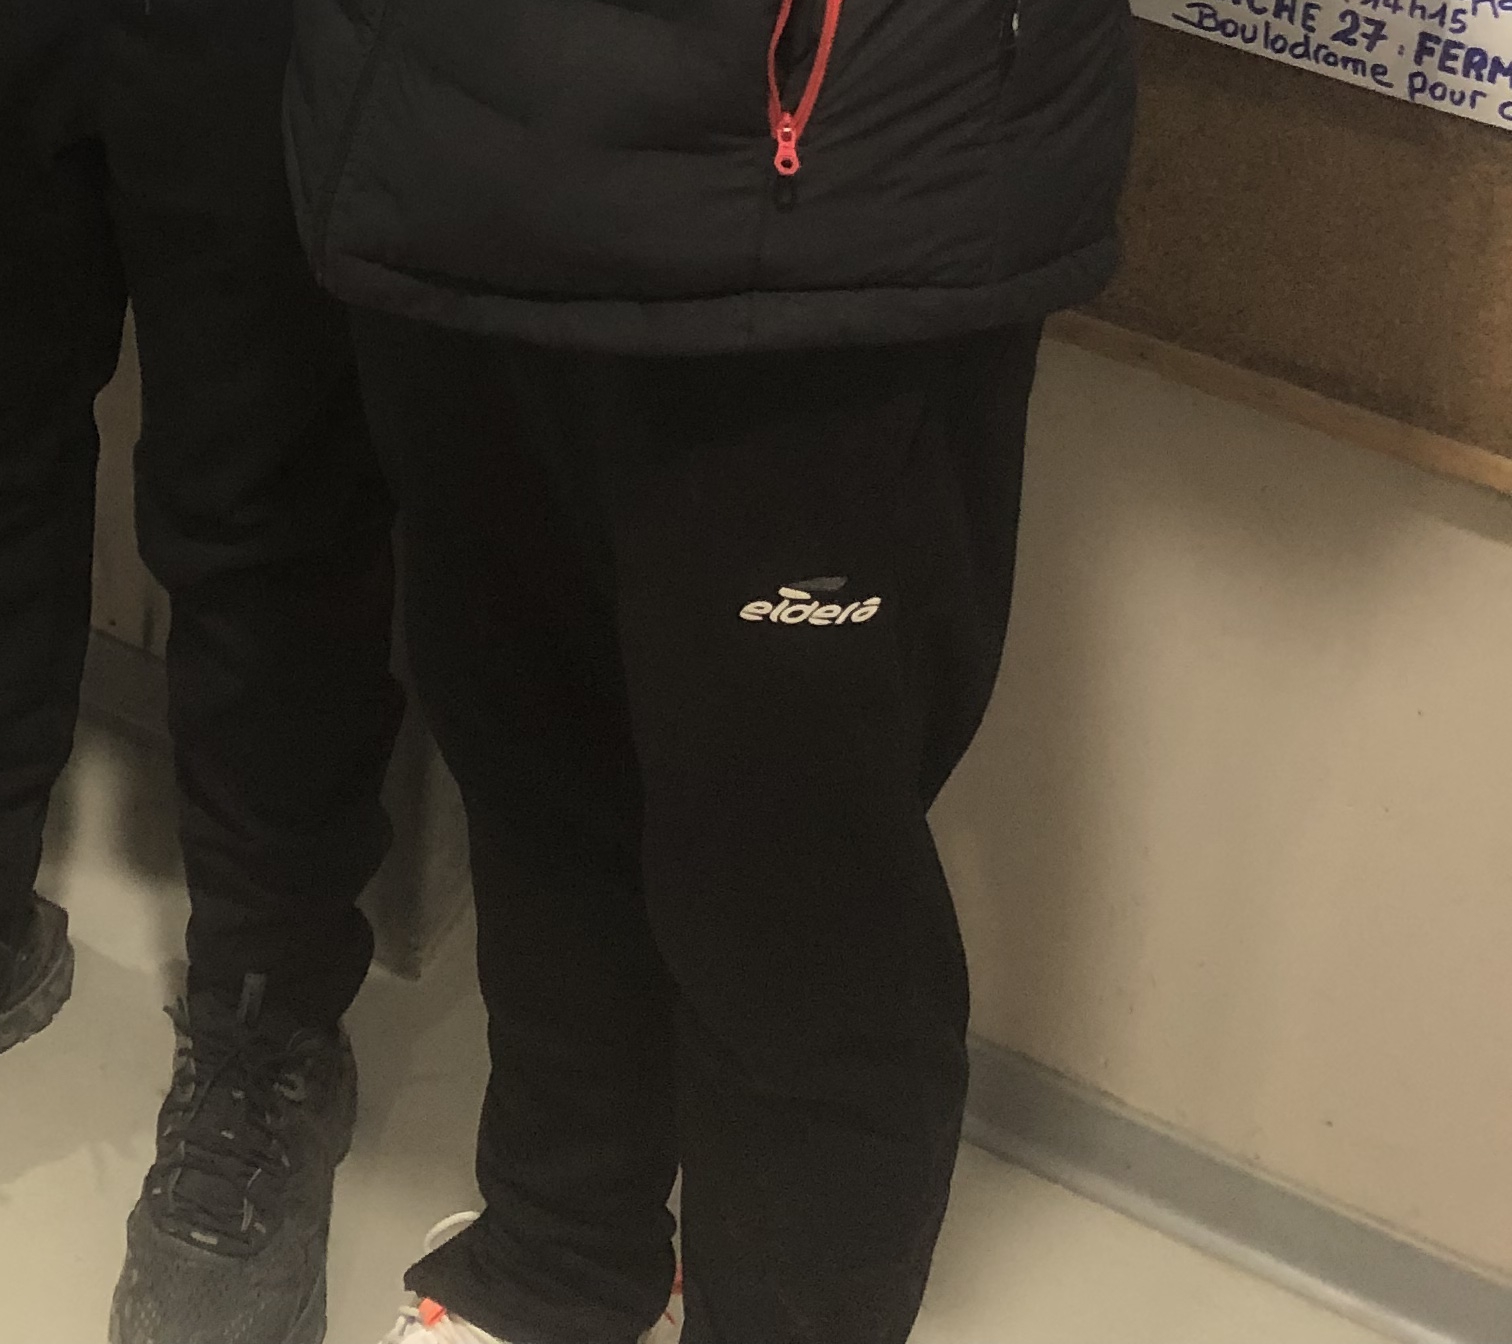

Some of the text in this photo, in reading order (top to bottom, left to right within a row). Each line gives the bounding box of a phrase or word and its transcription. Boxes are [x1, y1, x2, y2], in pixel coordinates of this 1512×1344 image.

[1170, 0, 1488, 110] Boulodrome pour
[1329, 8, 1389, 53] 27
